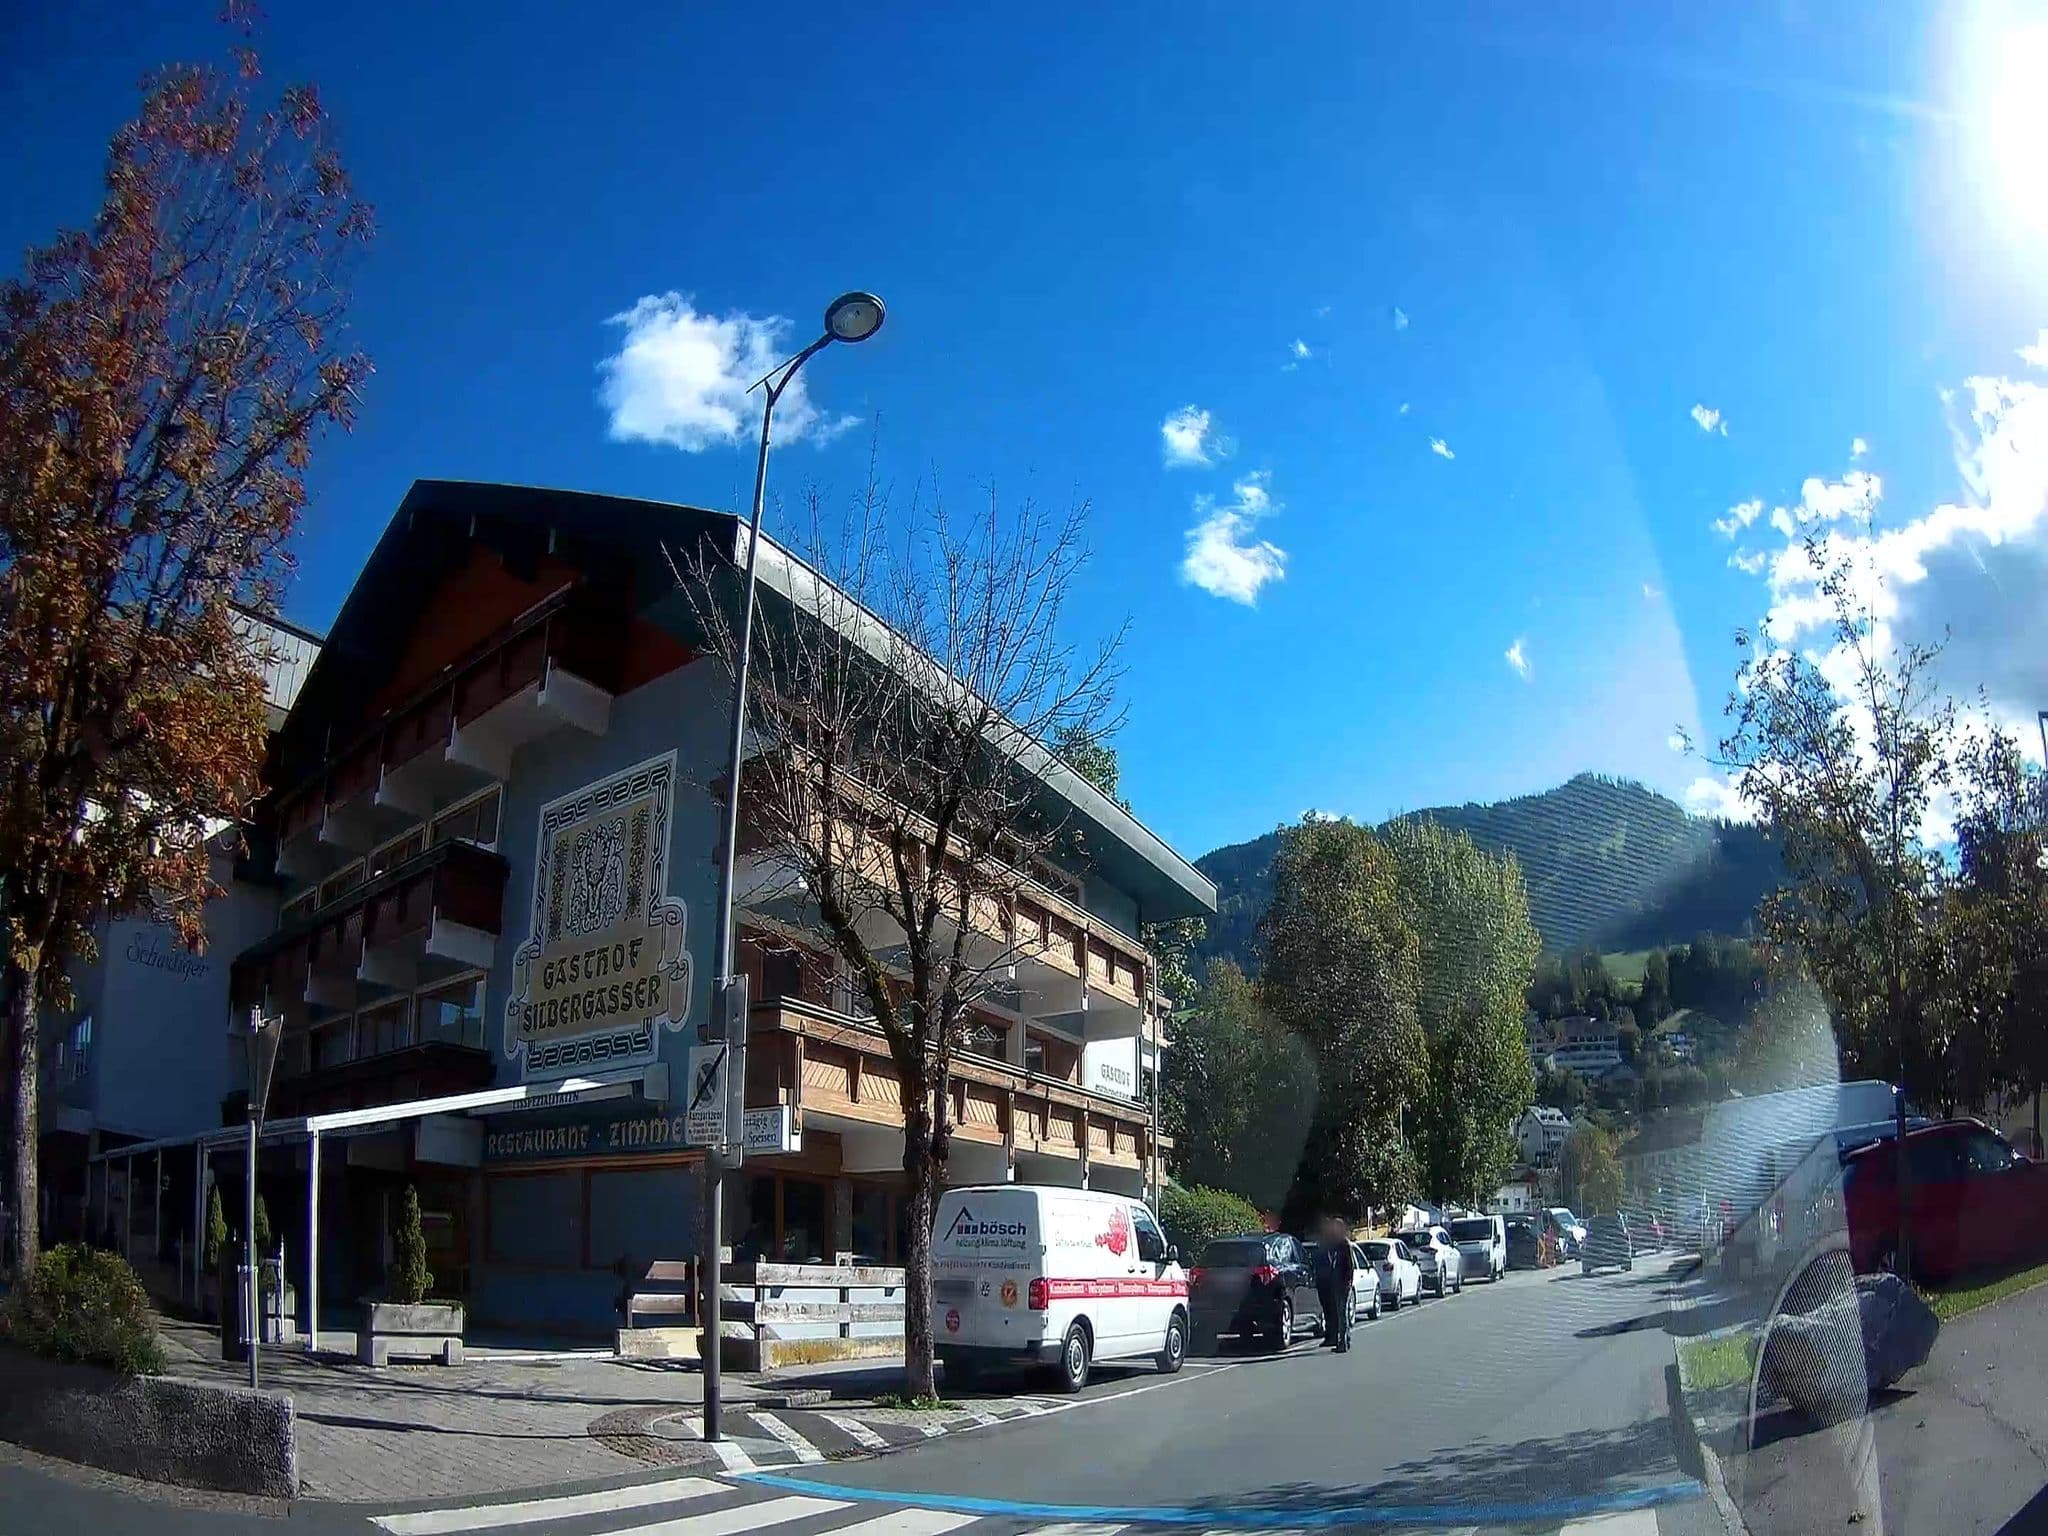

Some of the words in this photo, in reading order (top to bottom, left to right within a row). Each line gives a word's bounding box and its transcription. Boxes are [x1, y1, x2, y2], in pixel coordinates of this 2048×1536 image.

[543, 937, 643, 990] GASTHOF
[522, 975, 661, 1032] SILBERGASSER
[488, 1124, 590, 1155] RESTAURANT
[609, 1115, 684, 1147] ZIMME
[980, 1220, 1027, 1235] bösch
